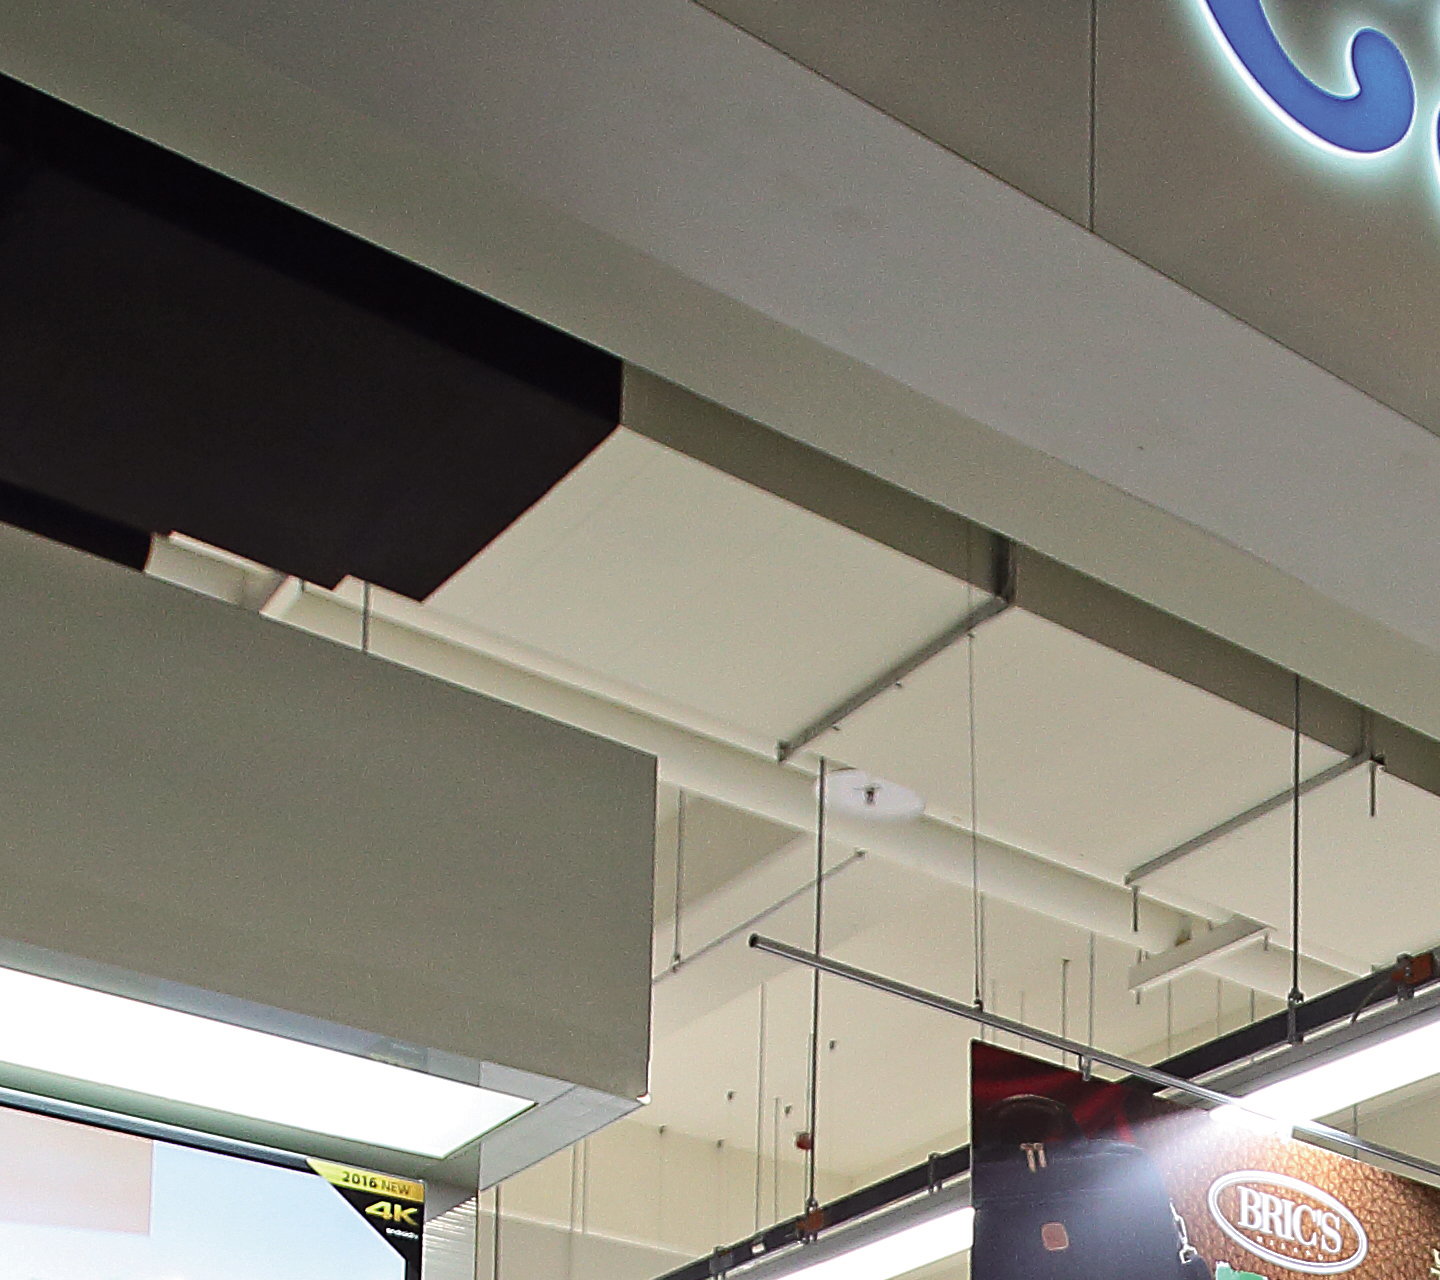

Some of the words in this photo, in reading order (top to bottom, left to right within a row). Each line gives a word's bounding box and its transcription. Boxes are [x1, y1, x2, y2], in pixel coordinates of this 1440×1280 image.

[341, 1170, 378, 1190] 2016
[380, 1179, 411, 1196] NEW
[364, 1200, 419, 1226] 4K
[1237, 1185, 1343, 1255] BRIC'S
